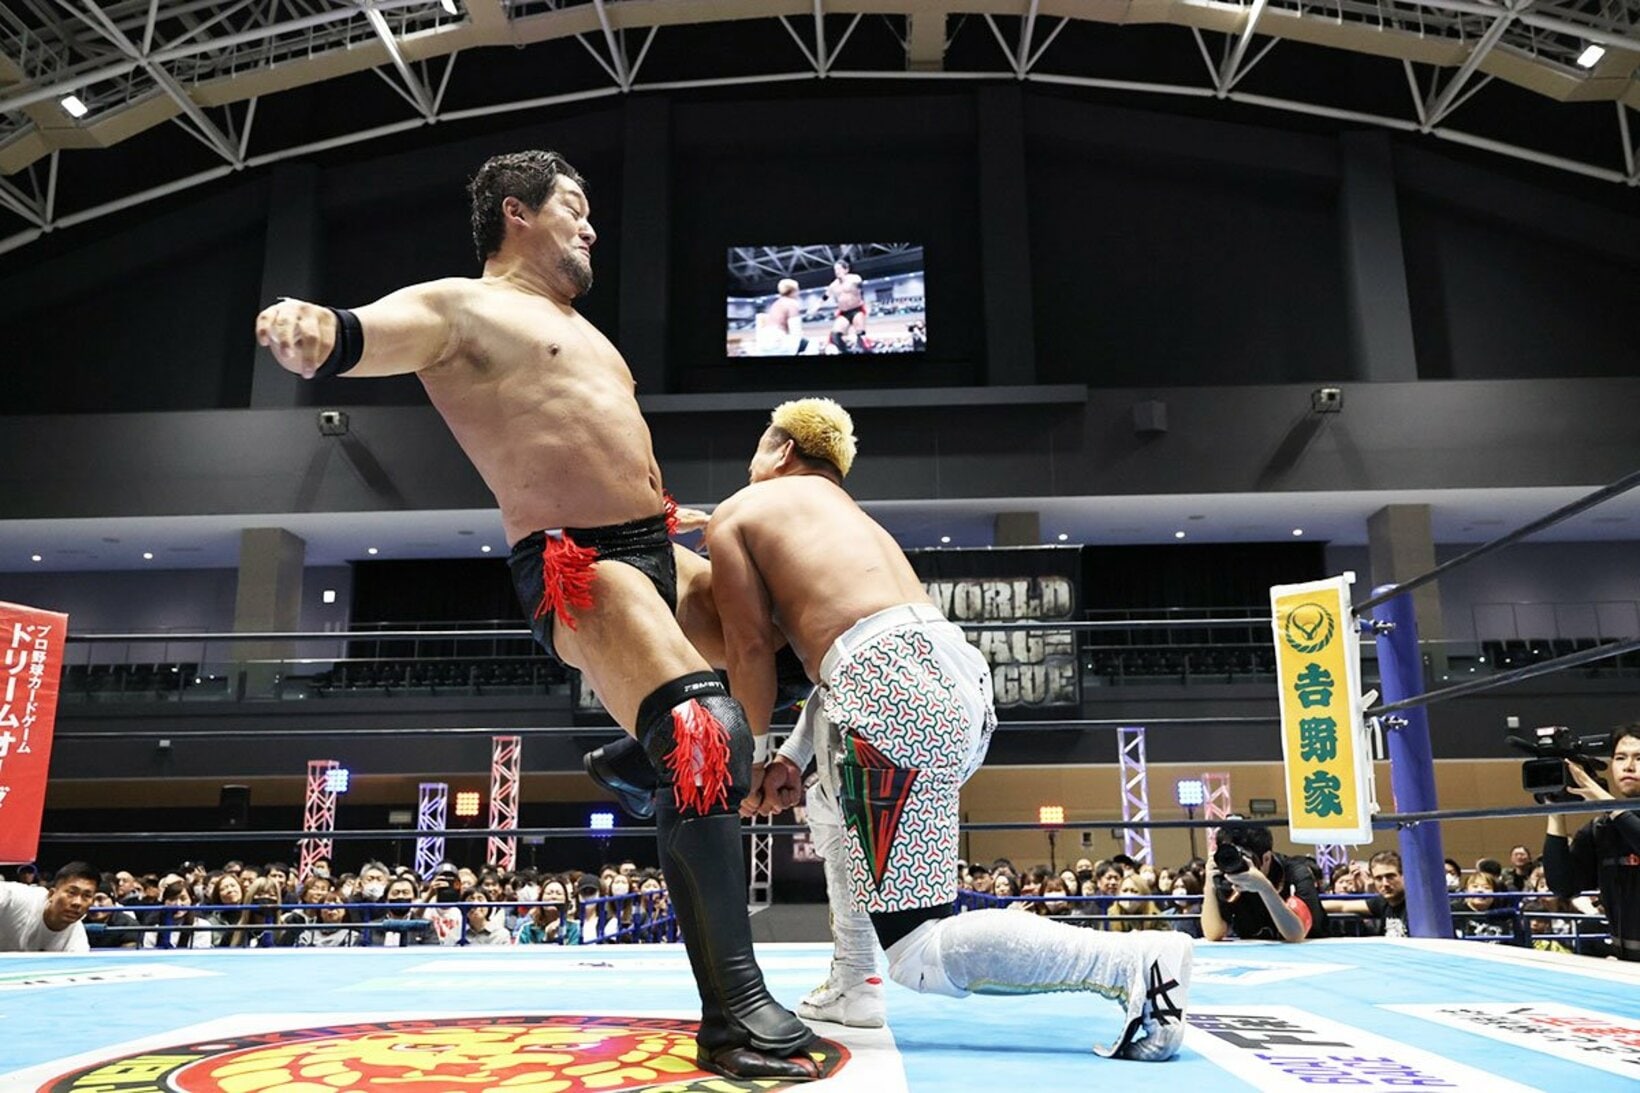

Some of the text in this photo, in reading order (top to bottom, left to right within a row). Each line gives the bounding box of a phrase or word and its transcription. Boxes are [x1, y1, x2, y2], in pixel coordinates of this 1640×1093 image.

[17, 625, 52, 754] プロ野球カードゲーム
[994, 665, 1074, 703] GUE
